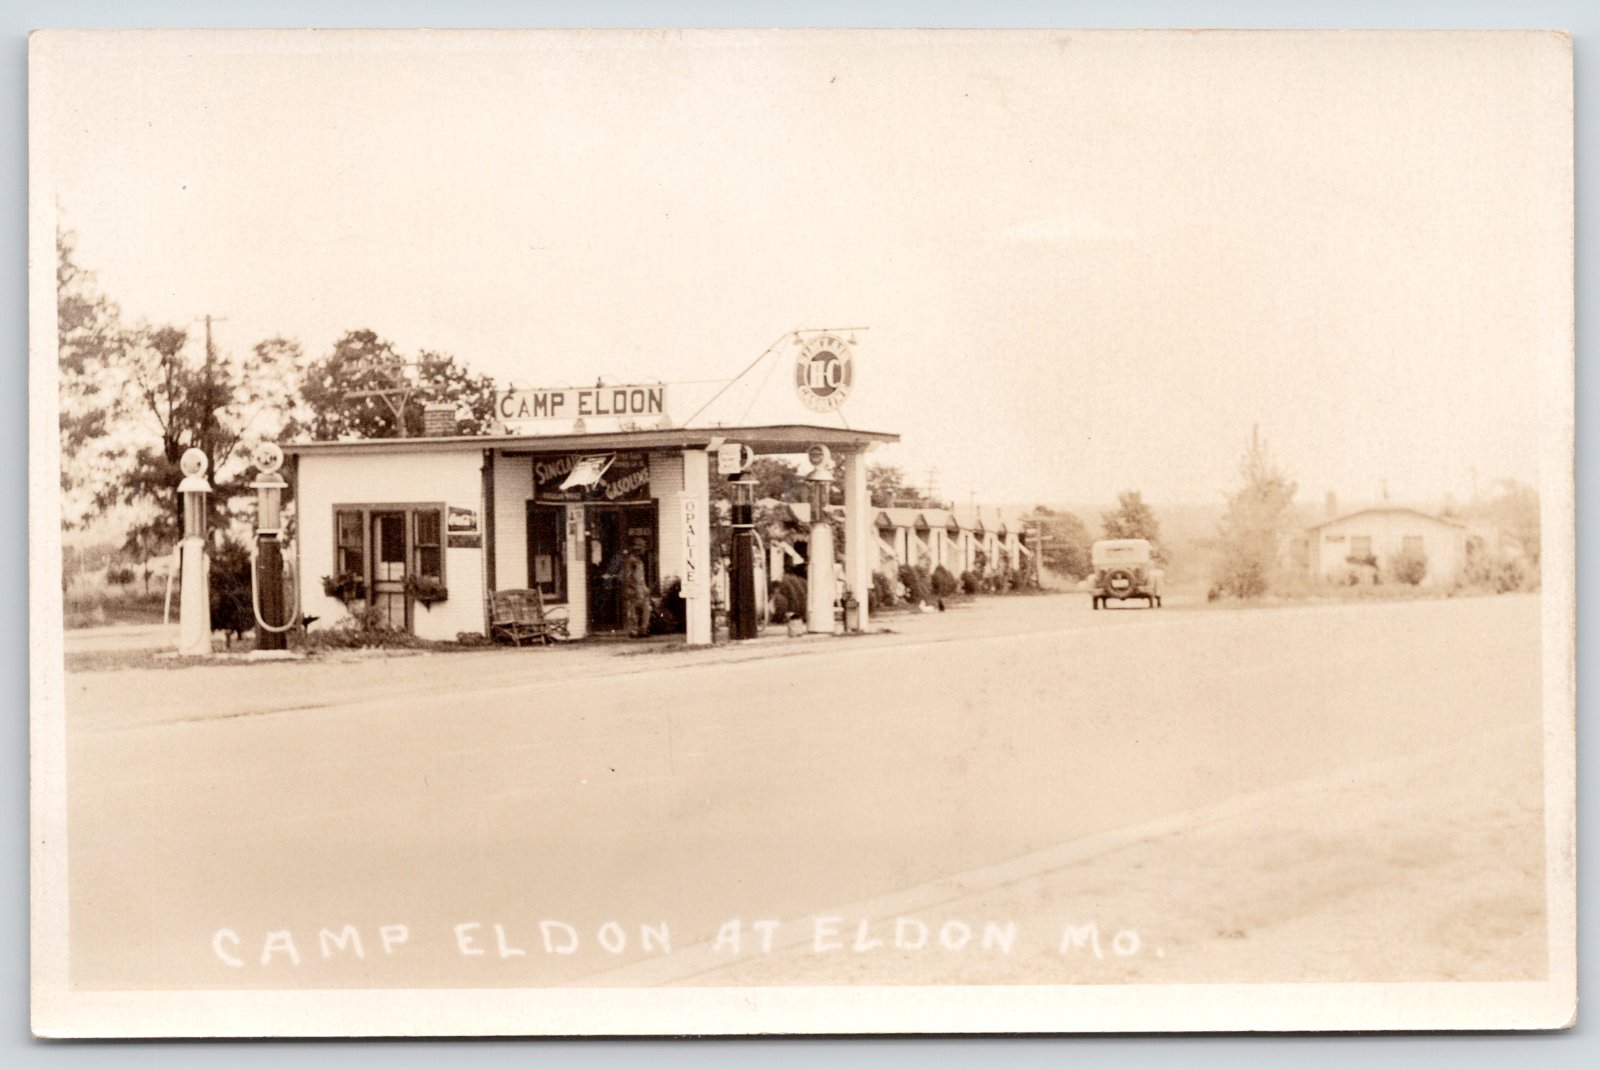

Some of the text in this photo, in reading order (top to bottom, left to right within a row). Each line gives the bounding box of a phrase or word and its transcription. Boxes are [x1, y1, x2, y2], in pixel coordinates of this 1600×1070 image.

[500, 388, 664, 419] CAMP ELDON
[685, 500, 696, 583] OPALINE
